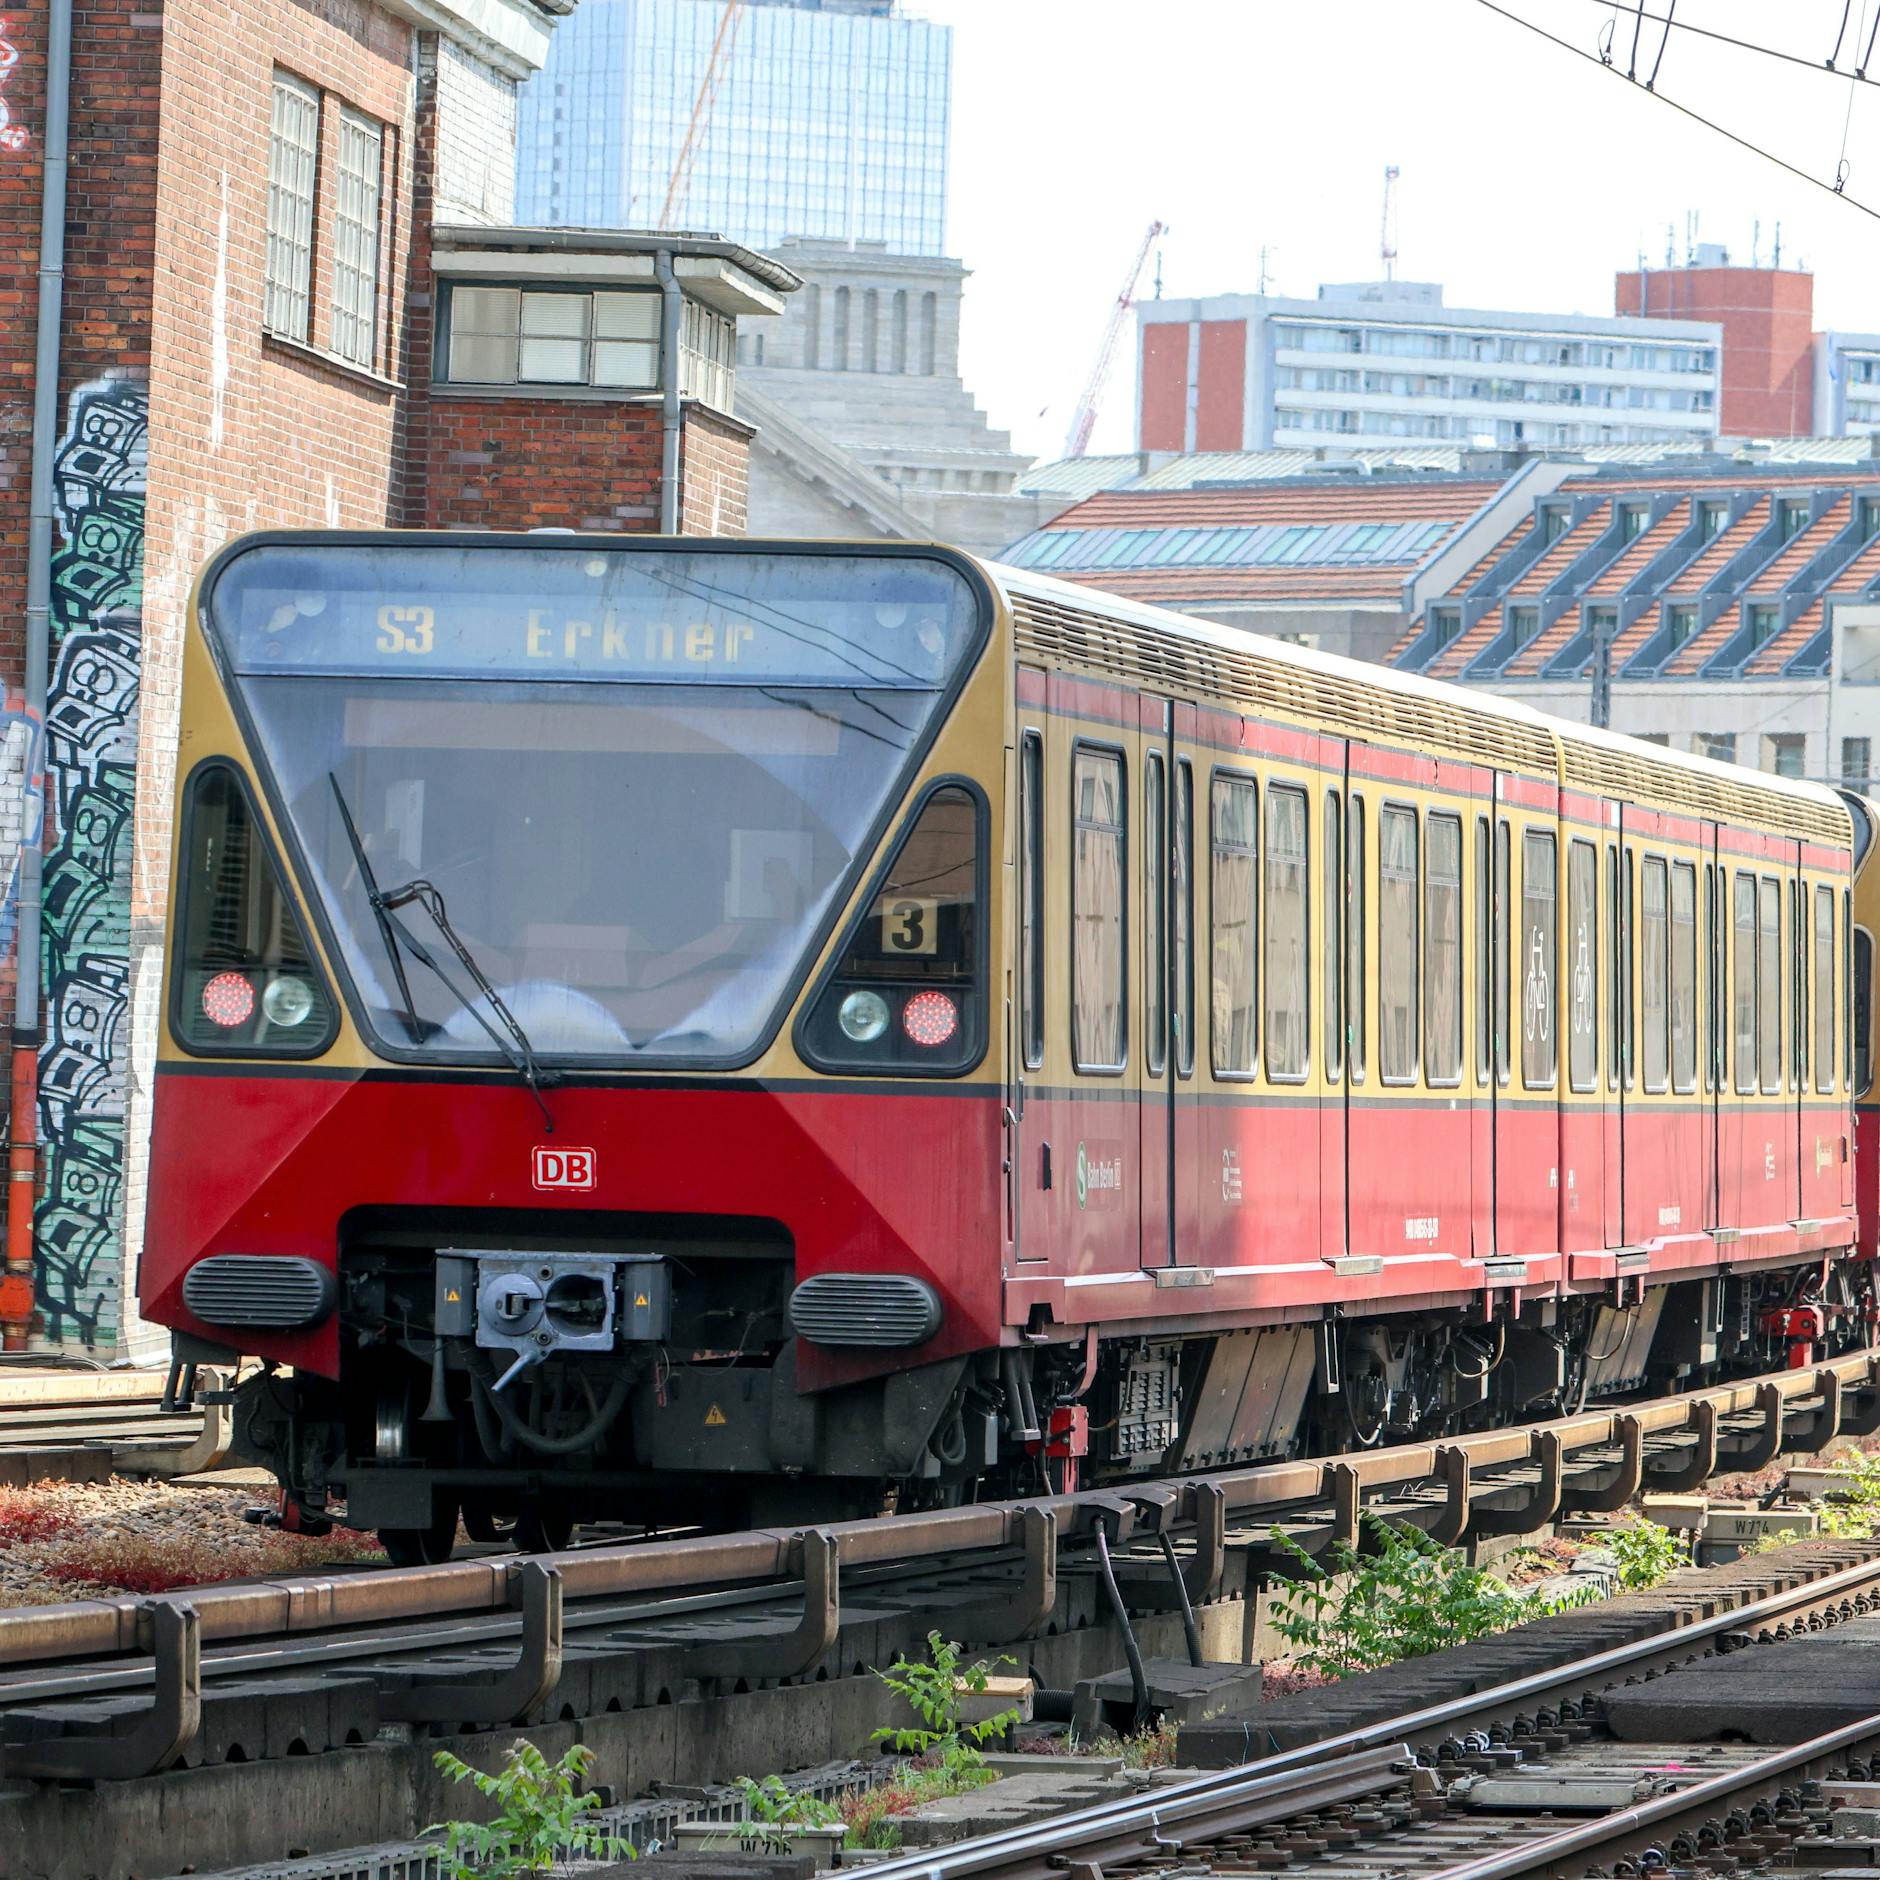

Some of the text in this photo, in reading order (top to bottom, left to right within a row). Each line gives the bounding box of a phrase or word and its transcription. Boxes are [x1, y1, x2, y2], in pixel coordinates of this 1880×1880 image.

[376, 605, 754, 662] S3 Erkner
[892, 901, 923, 949] 3
[541, 1154, 588, 1183] DB
[1735, 1519, 1746, 1534] W
